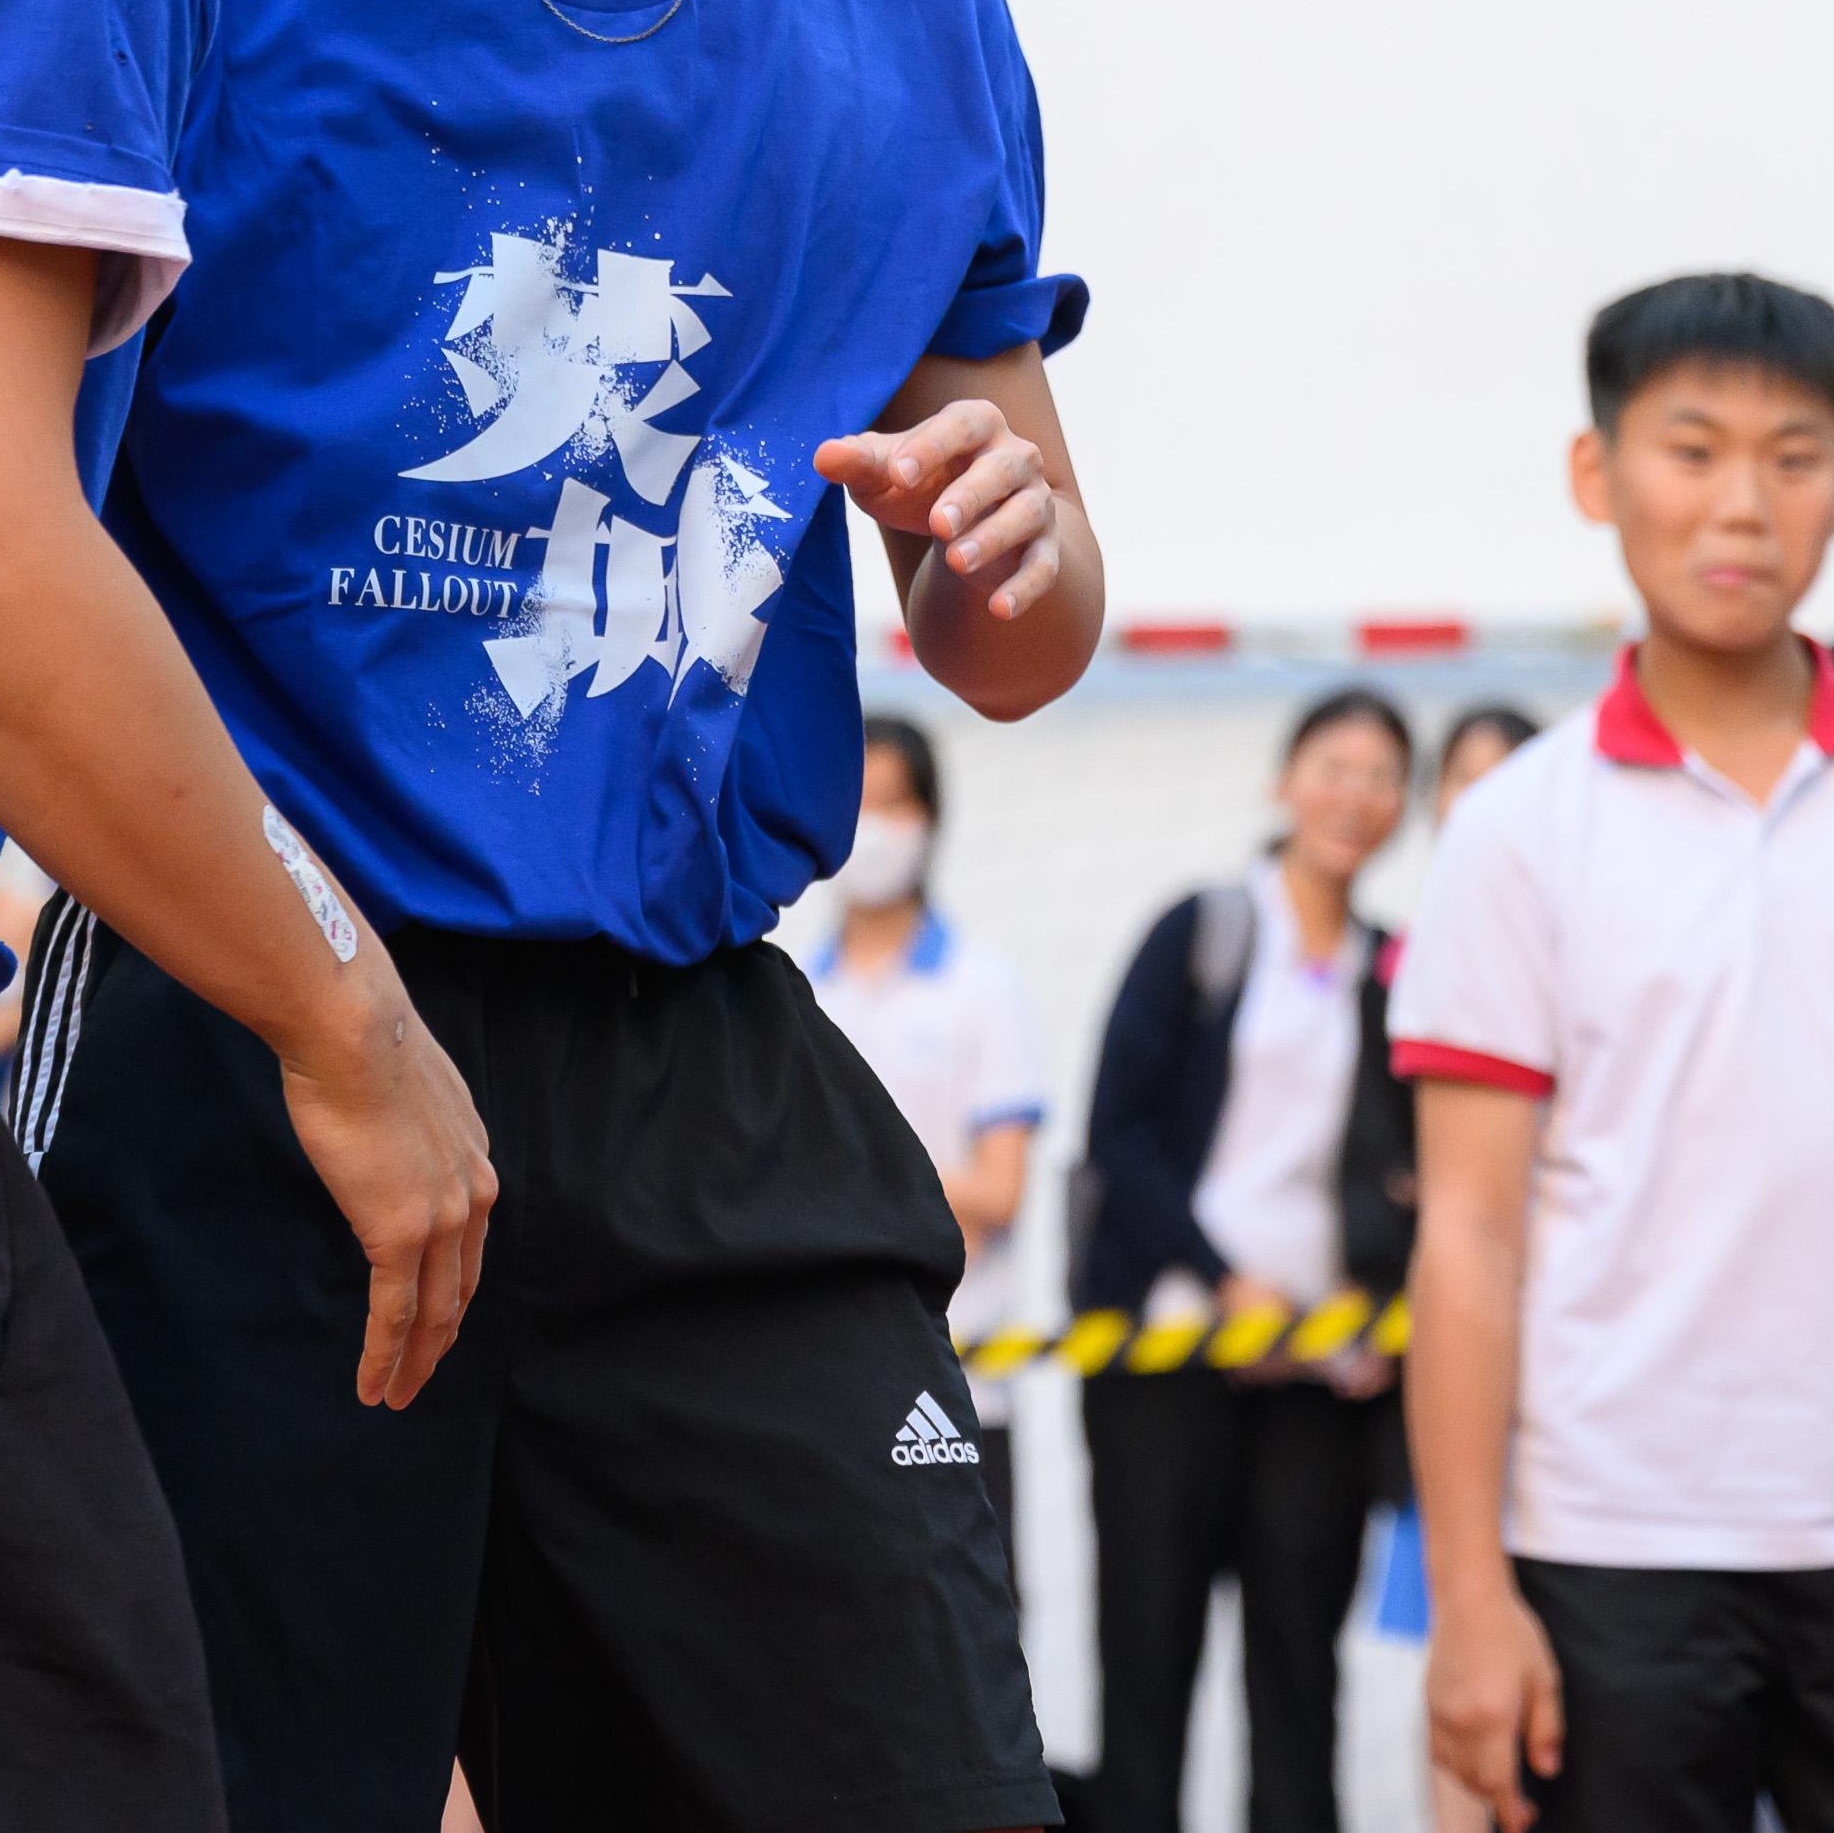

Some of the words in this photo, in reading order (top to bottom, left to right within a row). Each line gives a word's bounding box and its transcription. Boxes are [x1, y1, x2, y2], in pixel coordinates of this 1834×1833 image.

[373, 513, 522, 571] CESIUM
[326, 565, 519, 620] FALLOUT
[890, 1437, 980, 1466] adidas
